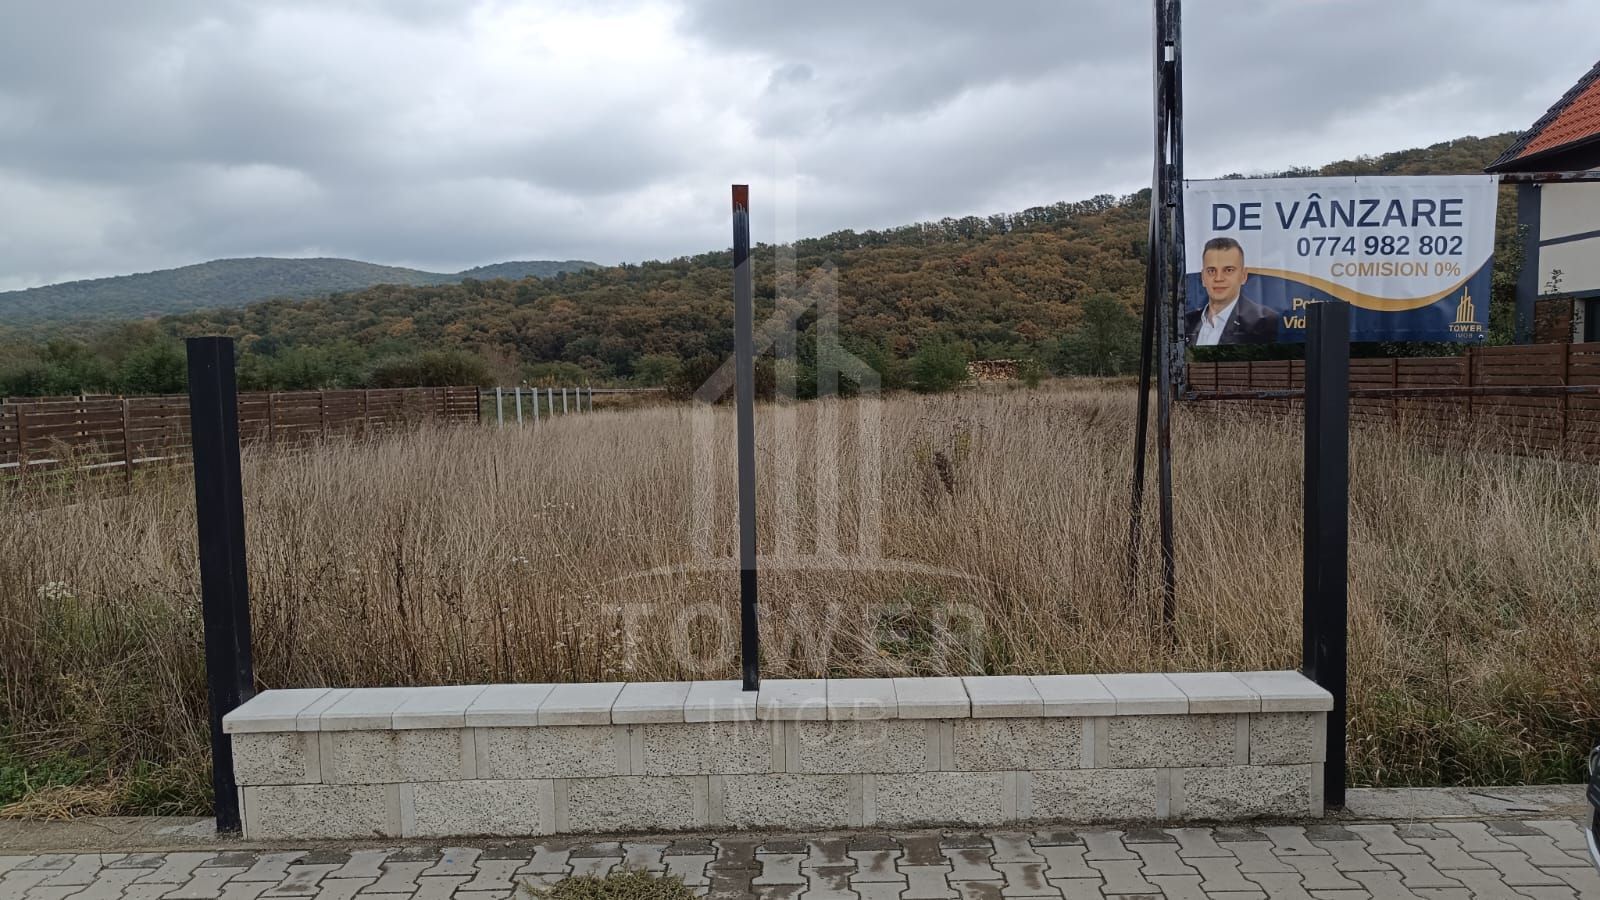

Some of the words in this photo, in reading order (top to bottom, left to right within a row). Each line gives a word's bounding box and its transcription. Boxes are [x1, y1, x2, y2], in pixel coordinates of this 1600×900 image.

[1212, 202, 1262, 231] DE
[1275, 192, 1464, 230] VÂNZARE
[1296, 236, 1356, 257] 0774
[1364, 235, 1410, 256] 982
[1419, 235, 1463, 256] 802
[1330, 262, 1429, 278] COMISION
[1434, 262, 1461, 277] 0%
[1448, 324, 1482, 332] TOWER
